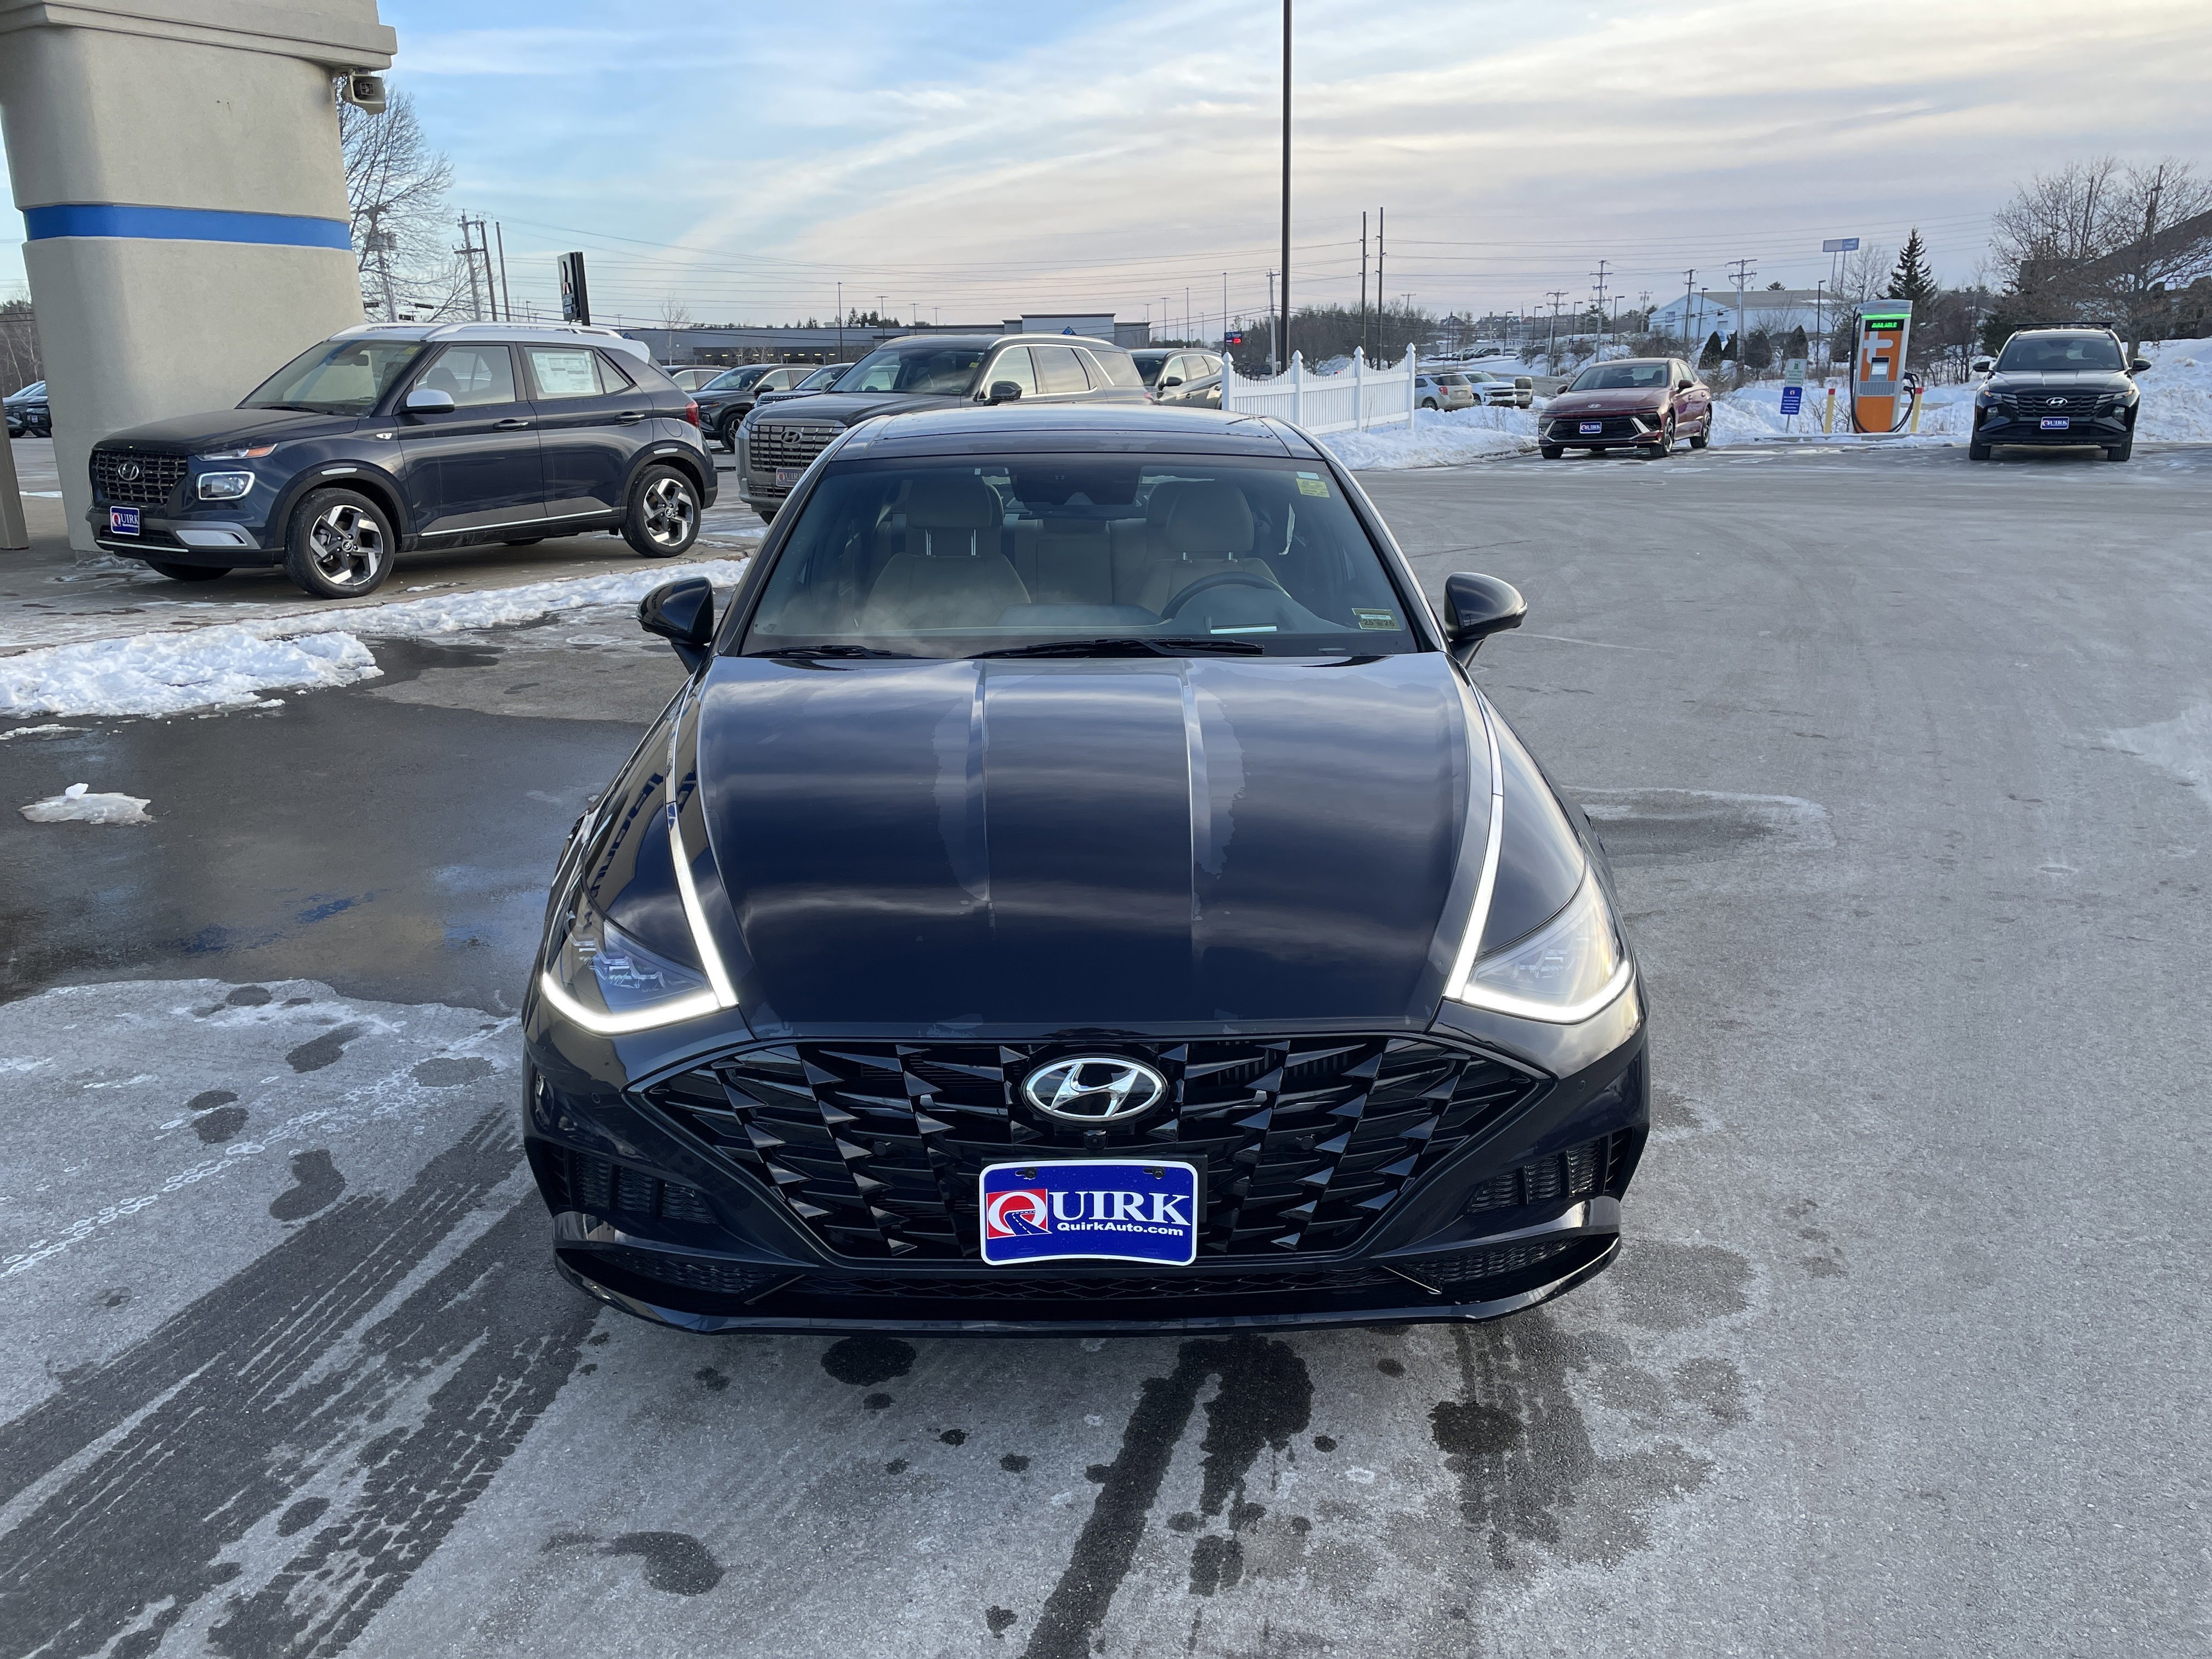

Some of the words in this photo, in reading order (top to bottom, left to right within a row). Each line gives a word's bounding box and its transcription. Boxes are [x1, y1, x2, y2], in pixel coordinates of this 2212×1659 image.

[112, 514, 138, 526] QUIRK
[988, 1191, 1192, 1234] QUIRK
[1057, 1222, 1183, 1236] QuirkAuto.com
